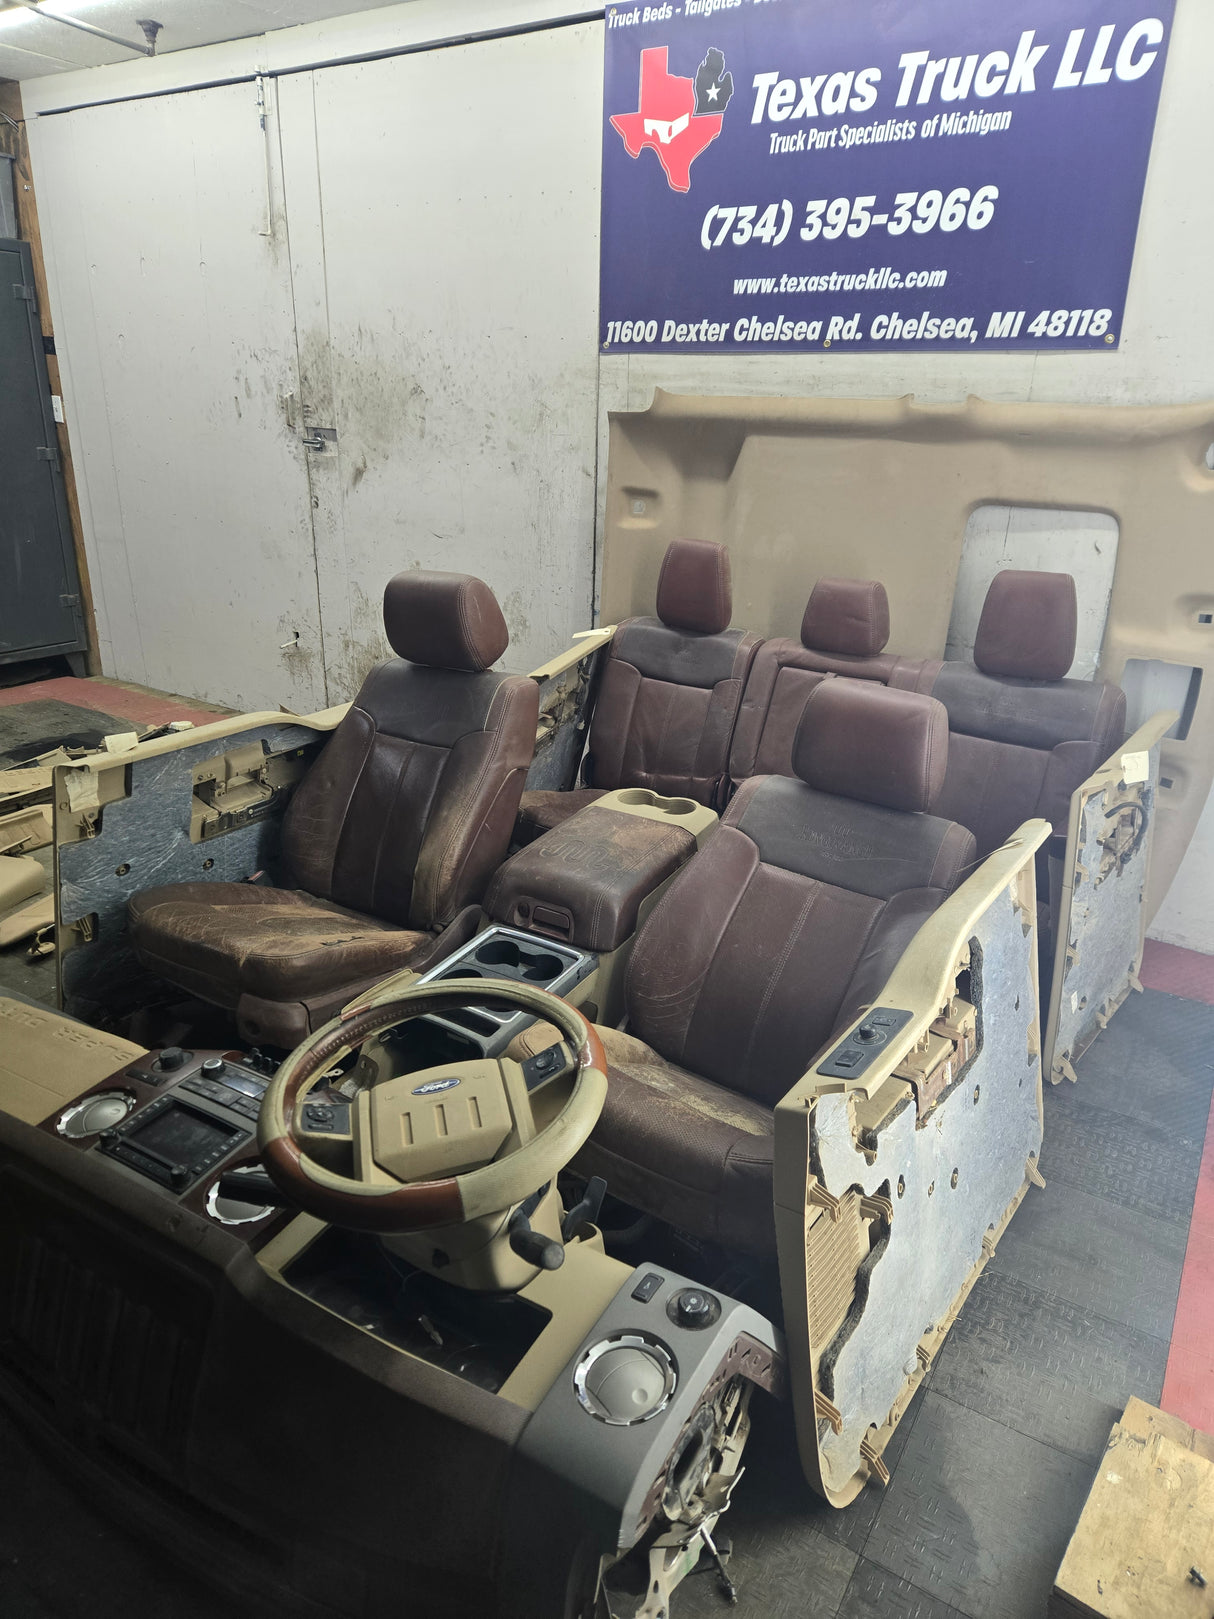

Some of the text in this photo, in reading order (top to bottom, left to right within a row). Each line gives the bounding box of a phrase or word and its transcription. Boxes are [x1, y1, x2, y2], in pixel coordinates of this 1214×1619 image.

[608, 8, 640, 29] Truck
[642, 2, 673, 23] Beds
[750, 17, 1164, 125] Texas Truck LLC
[769, 109, 1012, 155] Truck Part Specialists of Michigan
[700, 185, 999, 251] (734) 395-3966
[733, 267, 948, 295] www.texastruckllc.com
[604, 308, 1113, 344] 11600 Dexter Chelsea Rd. Chelsea, MI 48118
